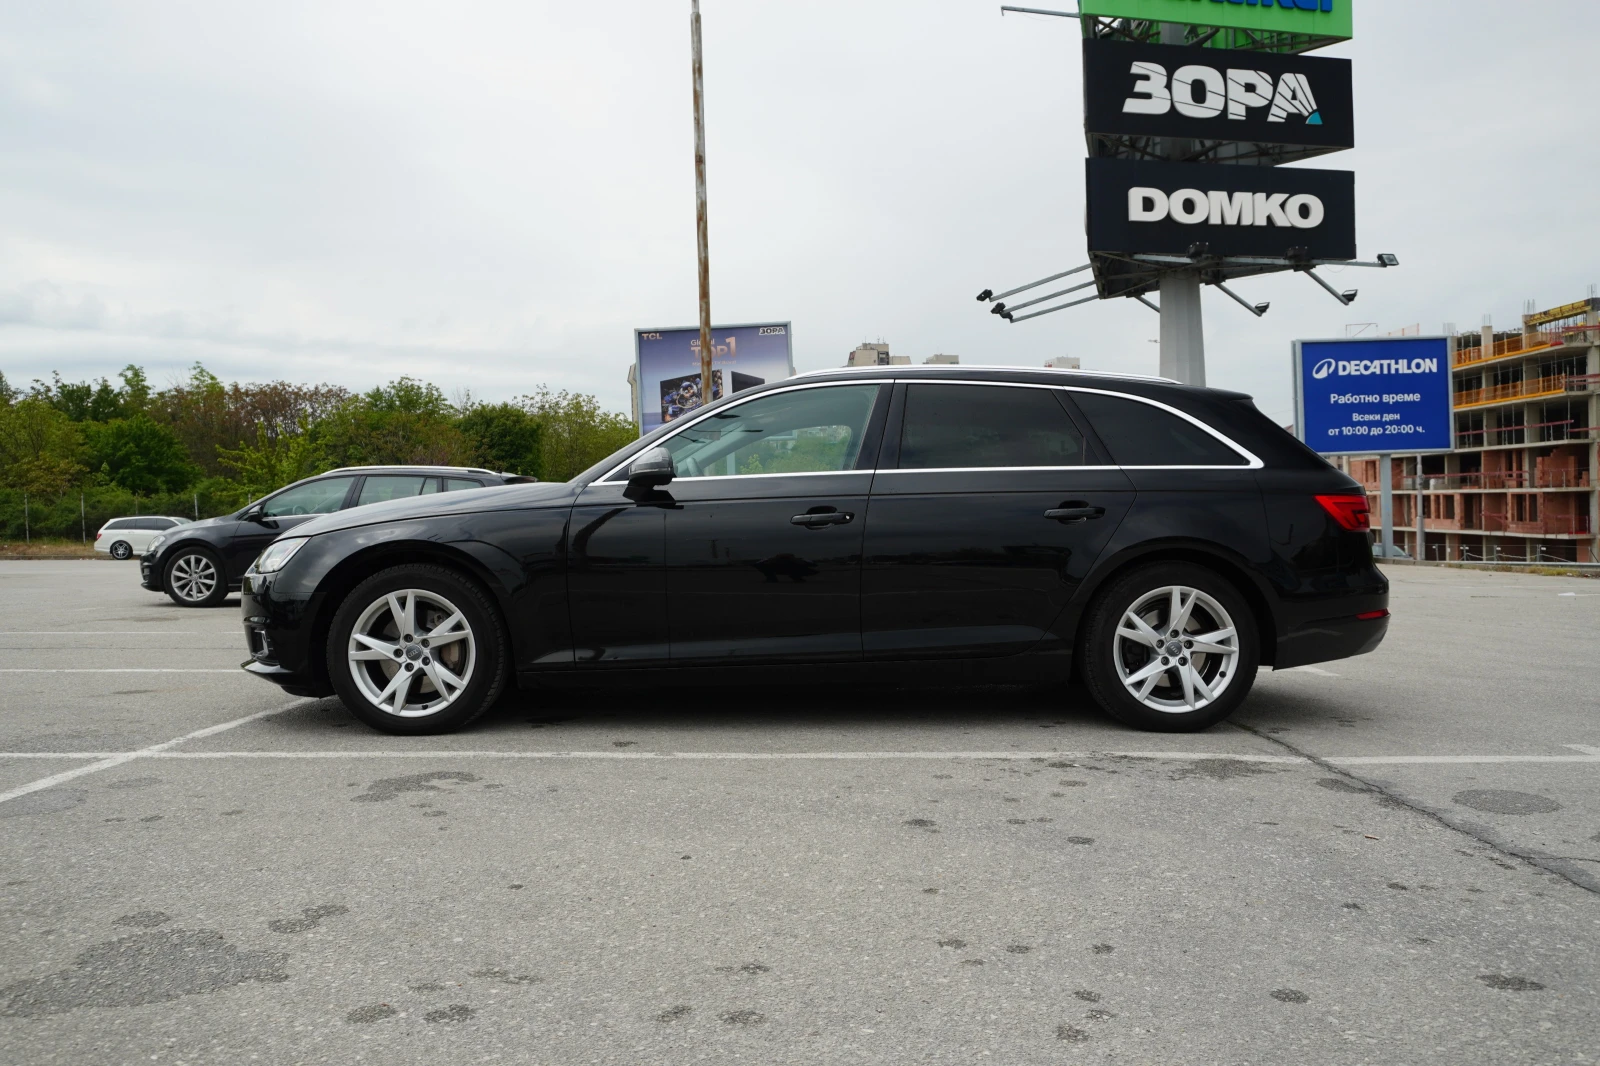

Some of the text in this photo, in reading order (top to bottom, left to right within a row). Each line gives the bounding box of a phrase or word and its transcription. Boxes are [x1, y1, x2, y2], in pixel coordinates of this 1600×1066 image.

[1122, 61, 1323, 125] ЗОРА
[1128, 186, 1325, 229] DOMKO
[641, 332, 663, 341] TCL
[758, 326, 786, 336] ЗОРА
[1338, 358, 1438, 376] DECATHLON
[1330, 393, 1421, 405] Работно време
[1352, 413, 1401, 422] Всеки ден
[1328, 425, 1426, 436] от 10:00 до 20:00 ч.
